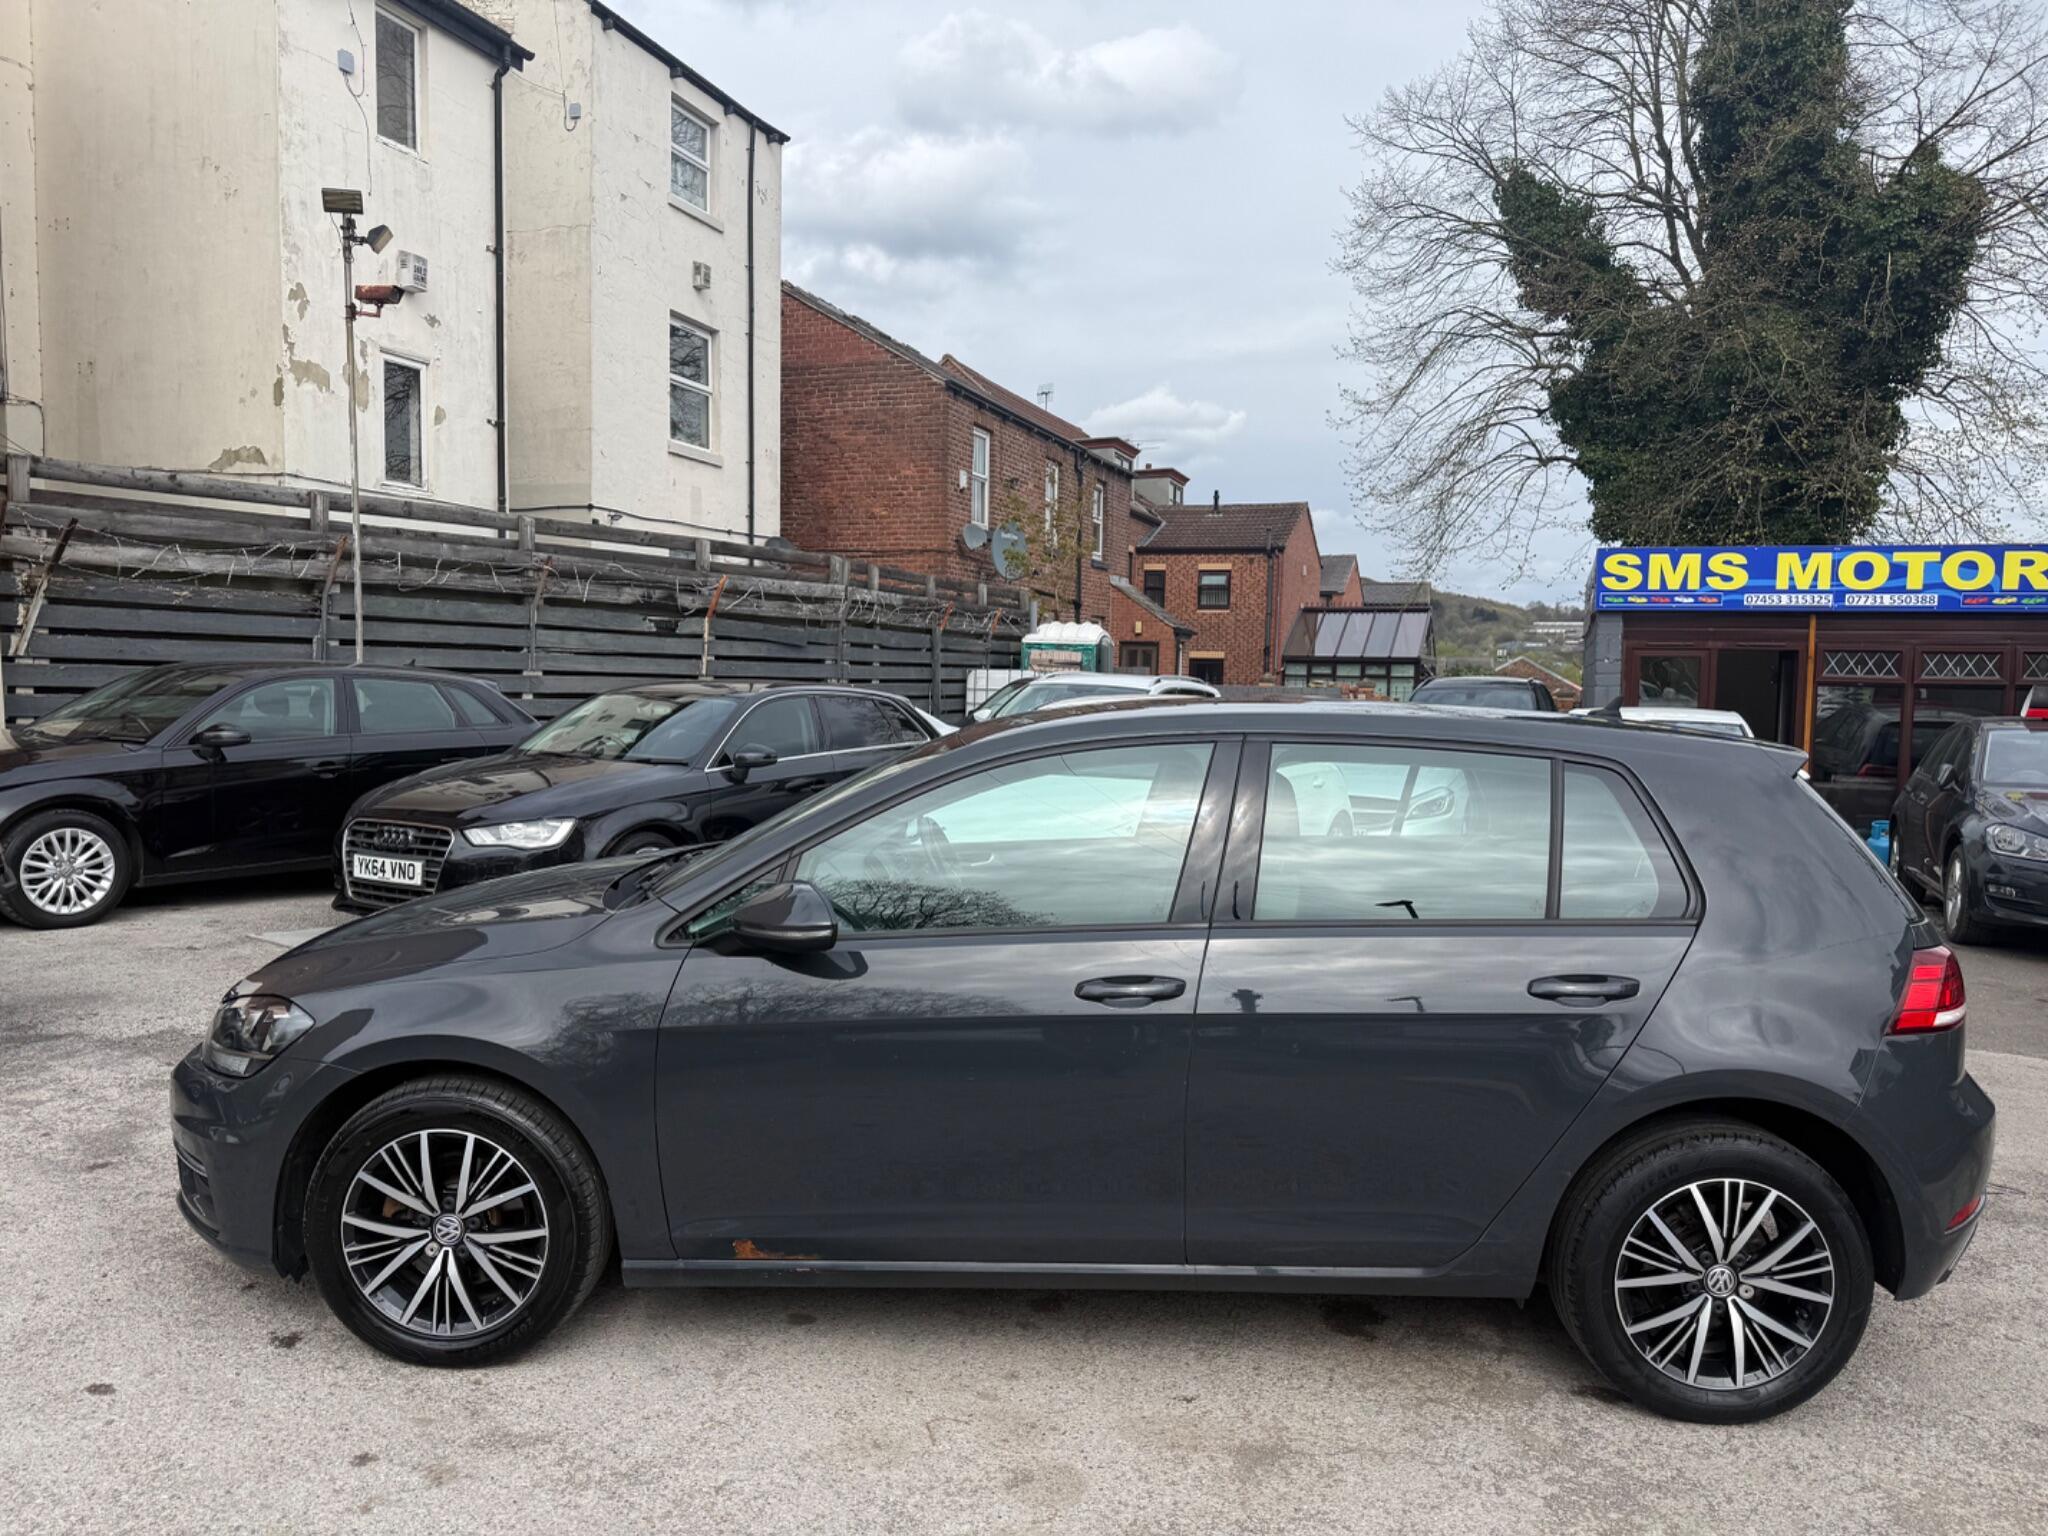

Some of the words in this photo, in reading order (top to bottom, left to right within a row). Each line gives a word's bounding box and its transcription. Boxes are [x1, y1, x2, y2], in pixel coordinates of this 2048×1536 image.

[1601, 551, 1749, 590] SMS
[1775, 550, 2048, 590] MOTOR
[1746, 595, 1782, 605] 07453
[1787, 595, 1831, 605] 315325
[1846, 595, 1884, 605] 07731
[1889, 595, 1936, 605] 550388
[357, 856, 387, 877] YK64
[389, 861, 416, 881] VNO
